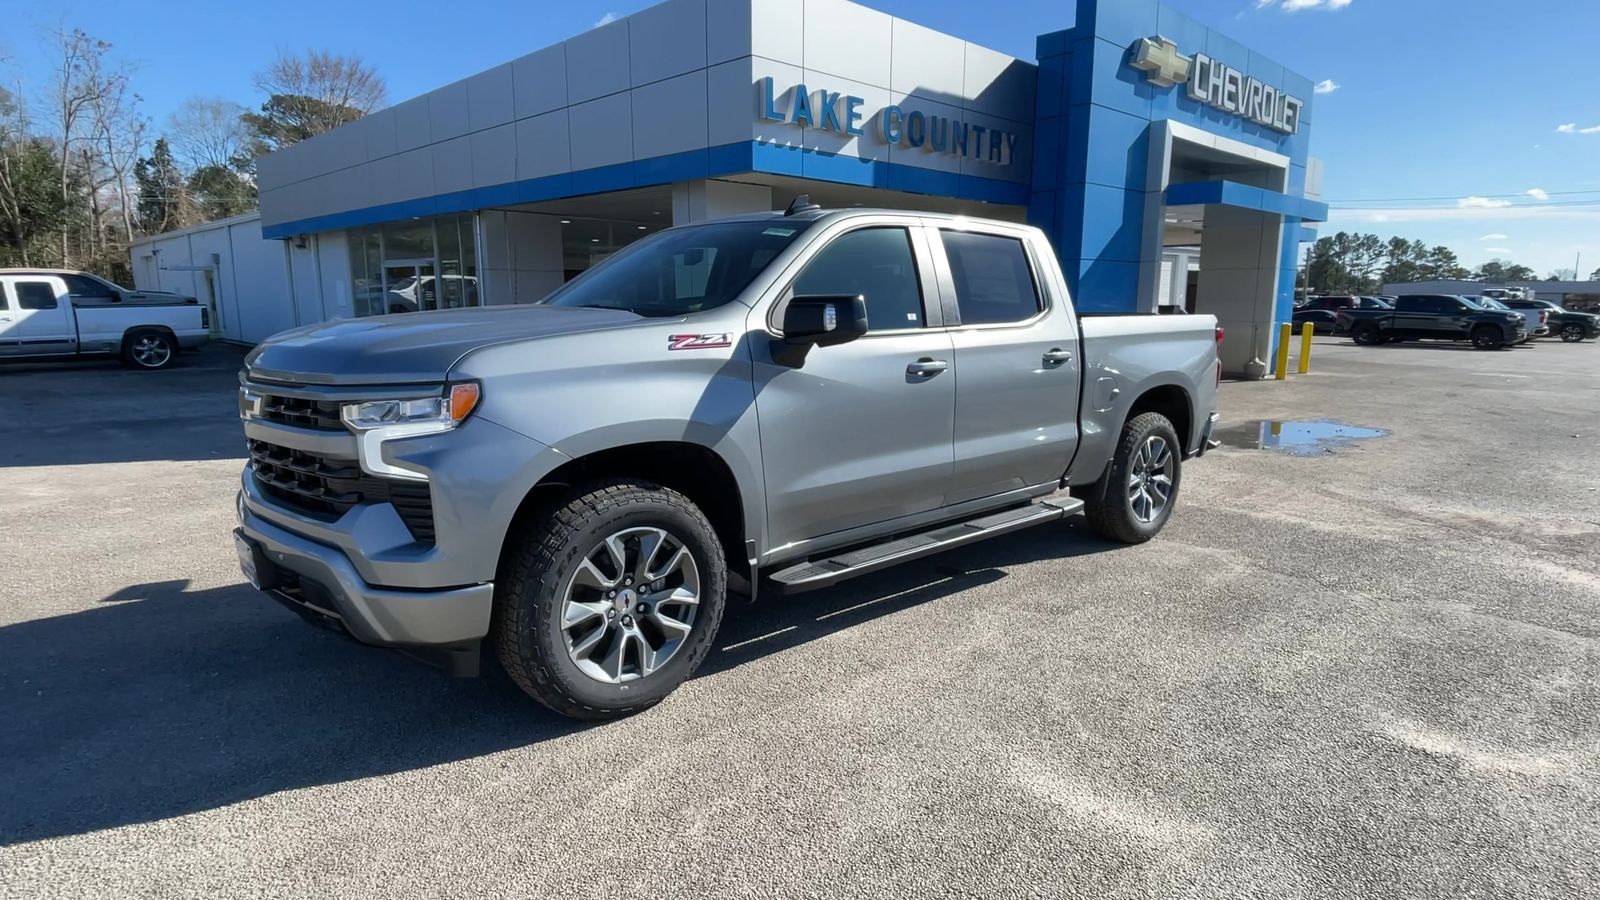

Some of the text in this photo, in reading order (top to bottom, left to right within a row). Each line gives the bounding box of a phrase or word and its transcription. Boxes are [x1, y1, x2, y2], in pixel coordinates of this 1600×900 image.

[762, 75, 1018, 165] LAKE COUNTRY
[1190, 52, 1304, 135] CHEVROLET
[667, 332, 734, 351] Z71
